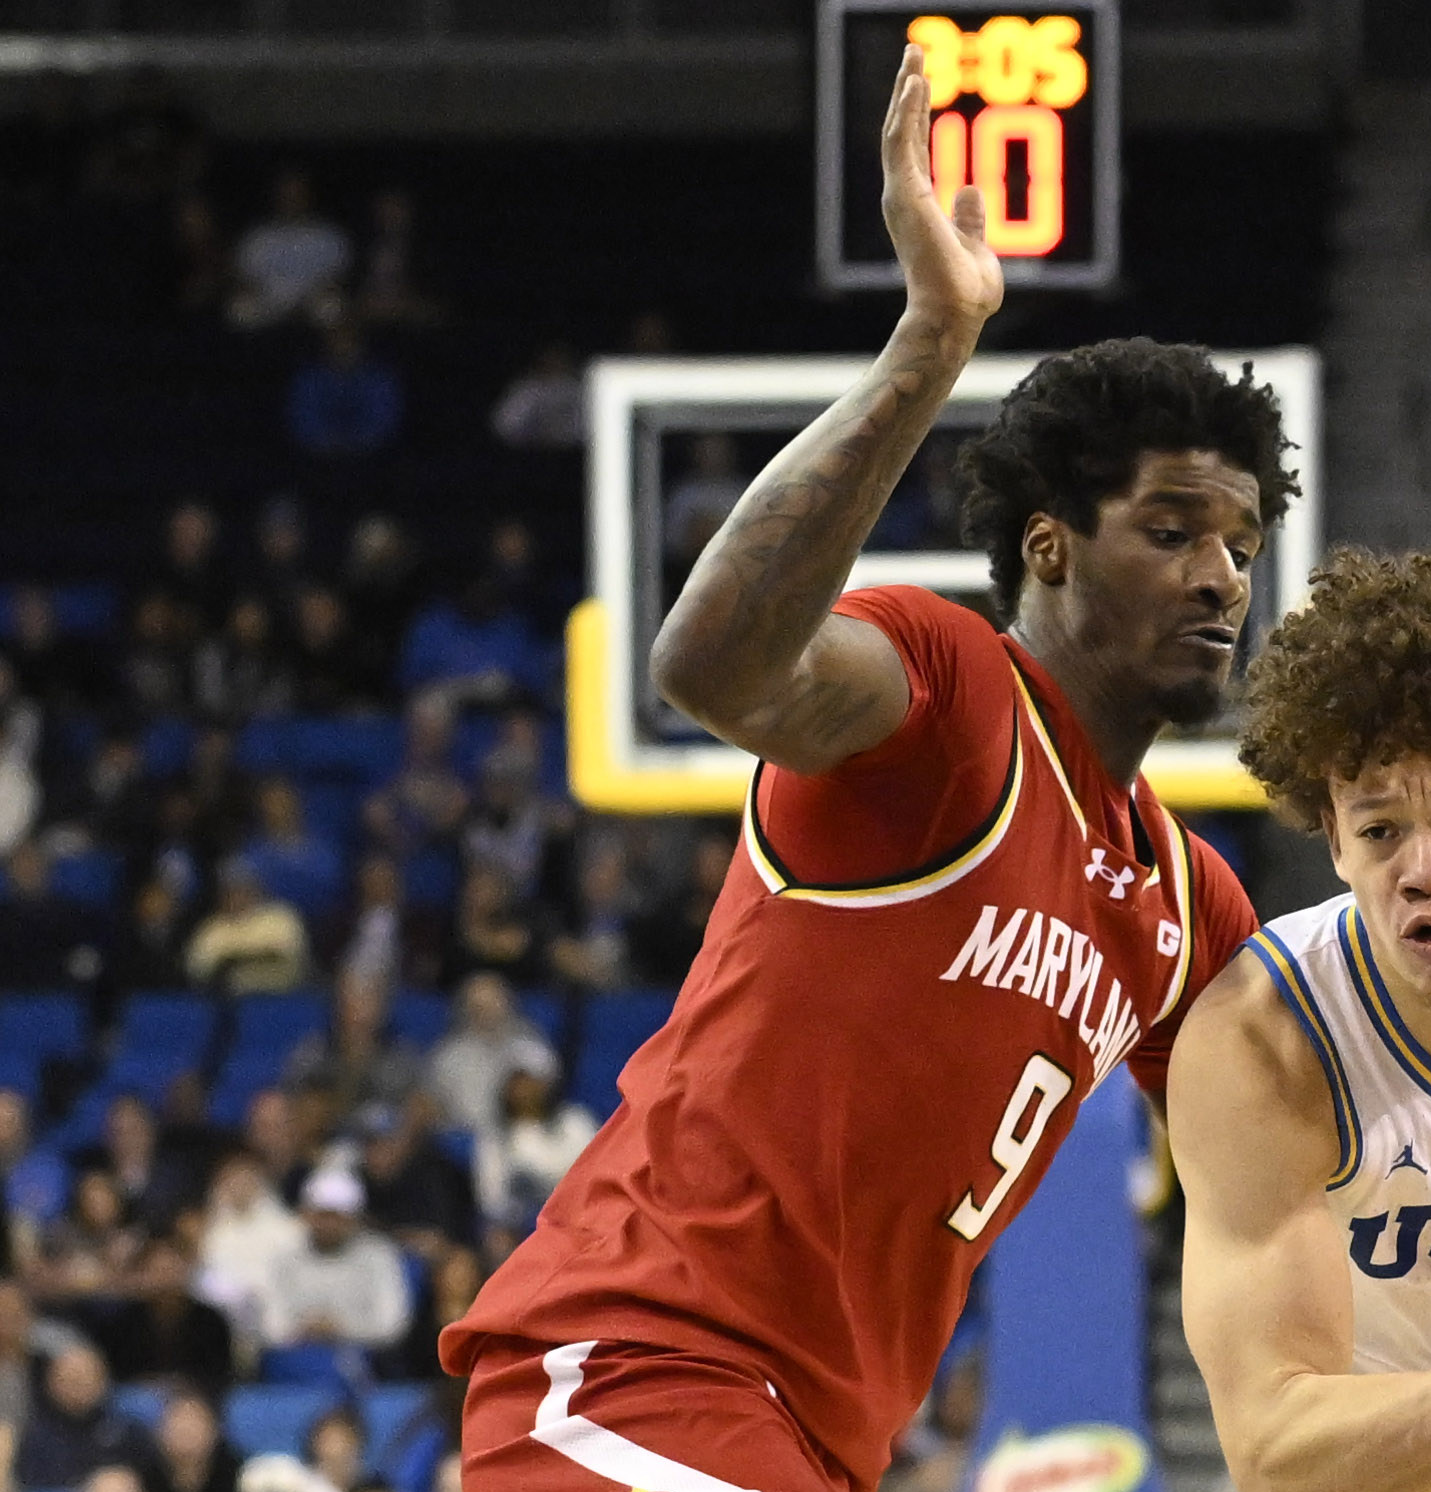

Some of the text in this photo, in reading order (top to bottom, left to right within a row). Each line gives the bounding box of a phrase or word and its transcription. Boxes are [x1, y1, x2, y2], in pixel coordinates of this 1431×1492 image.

[907, 15, 1087, 109] 3:05
[931, 105, 1064, 257] 10
[939, 905, 1141, 1104] MARYLAN
[945, 1051, 1074, 1241] 9
